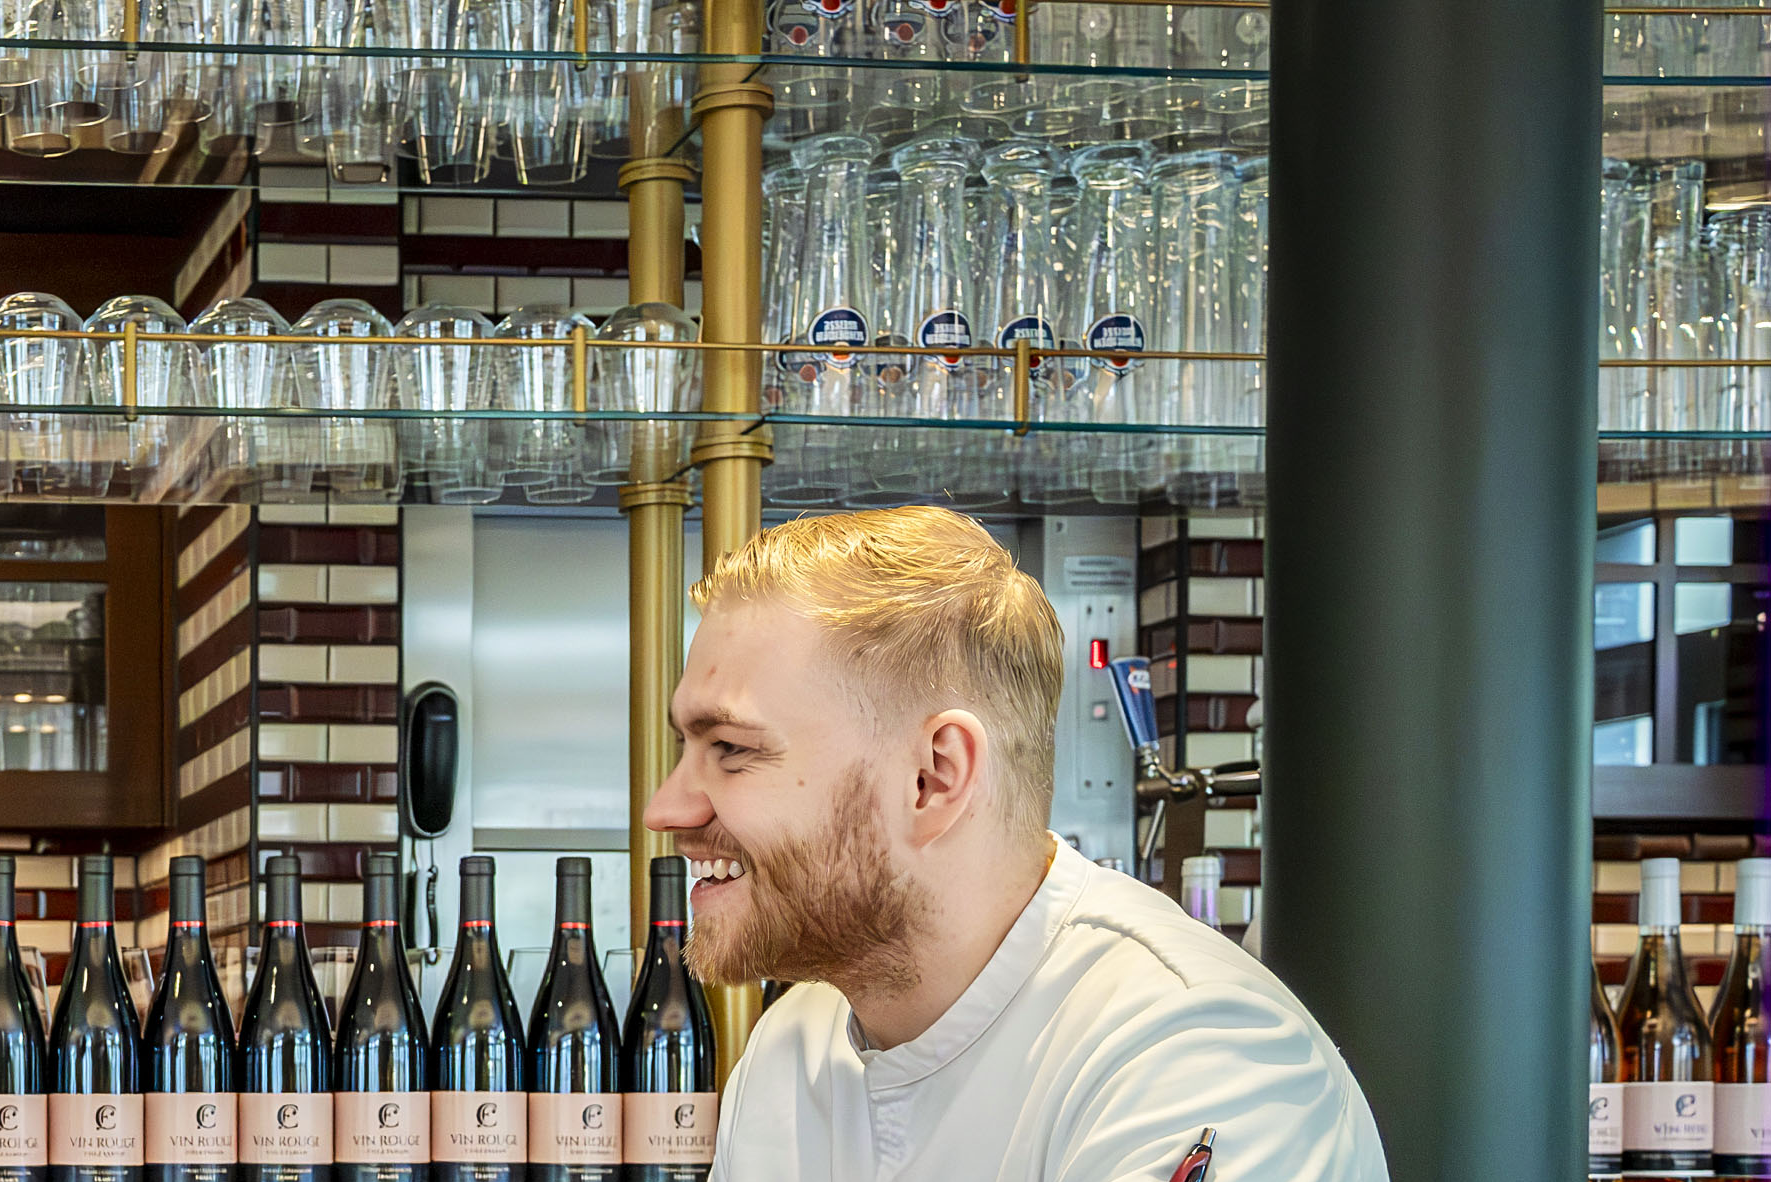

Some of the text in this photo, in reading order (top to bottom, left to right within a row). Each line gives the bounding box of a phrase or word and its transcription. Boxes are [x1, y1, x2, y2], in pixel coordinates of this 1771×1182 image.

[70, 1136, 92, 1148] VIN
[170, 1135, 193, 1147] VIN
[253, 1135, 275, 1147] VIN
[352, 1134, 374, 1147] VIN
[451, 1133, 473, 1145] VIN
[556, 1134, 579, 1147] VIN
[648, 1134, 671, 1147] VIN
